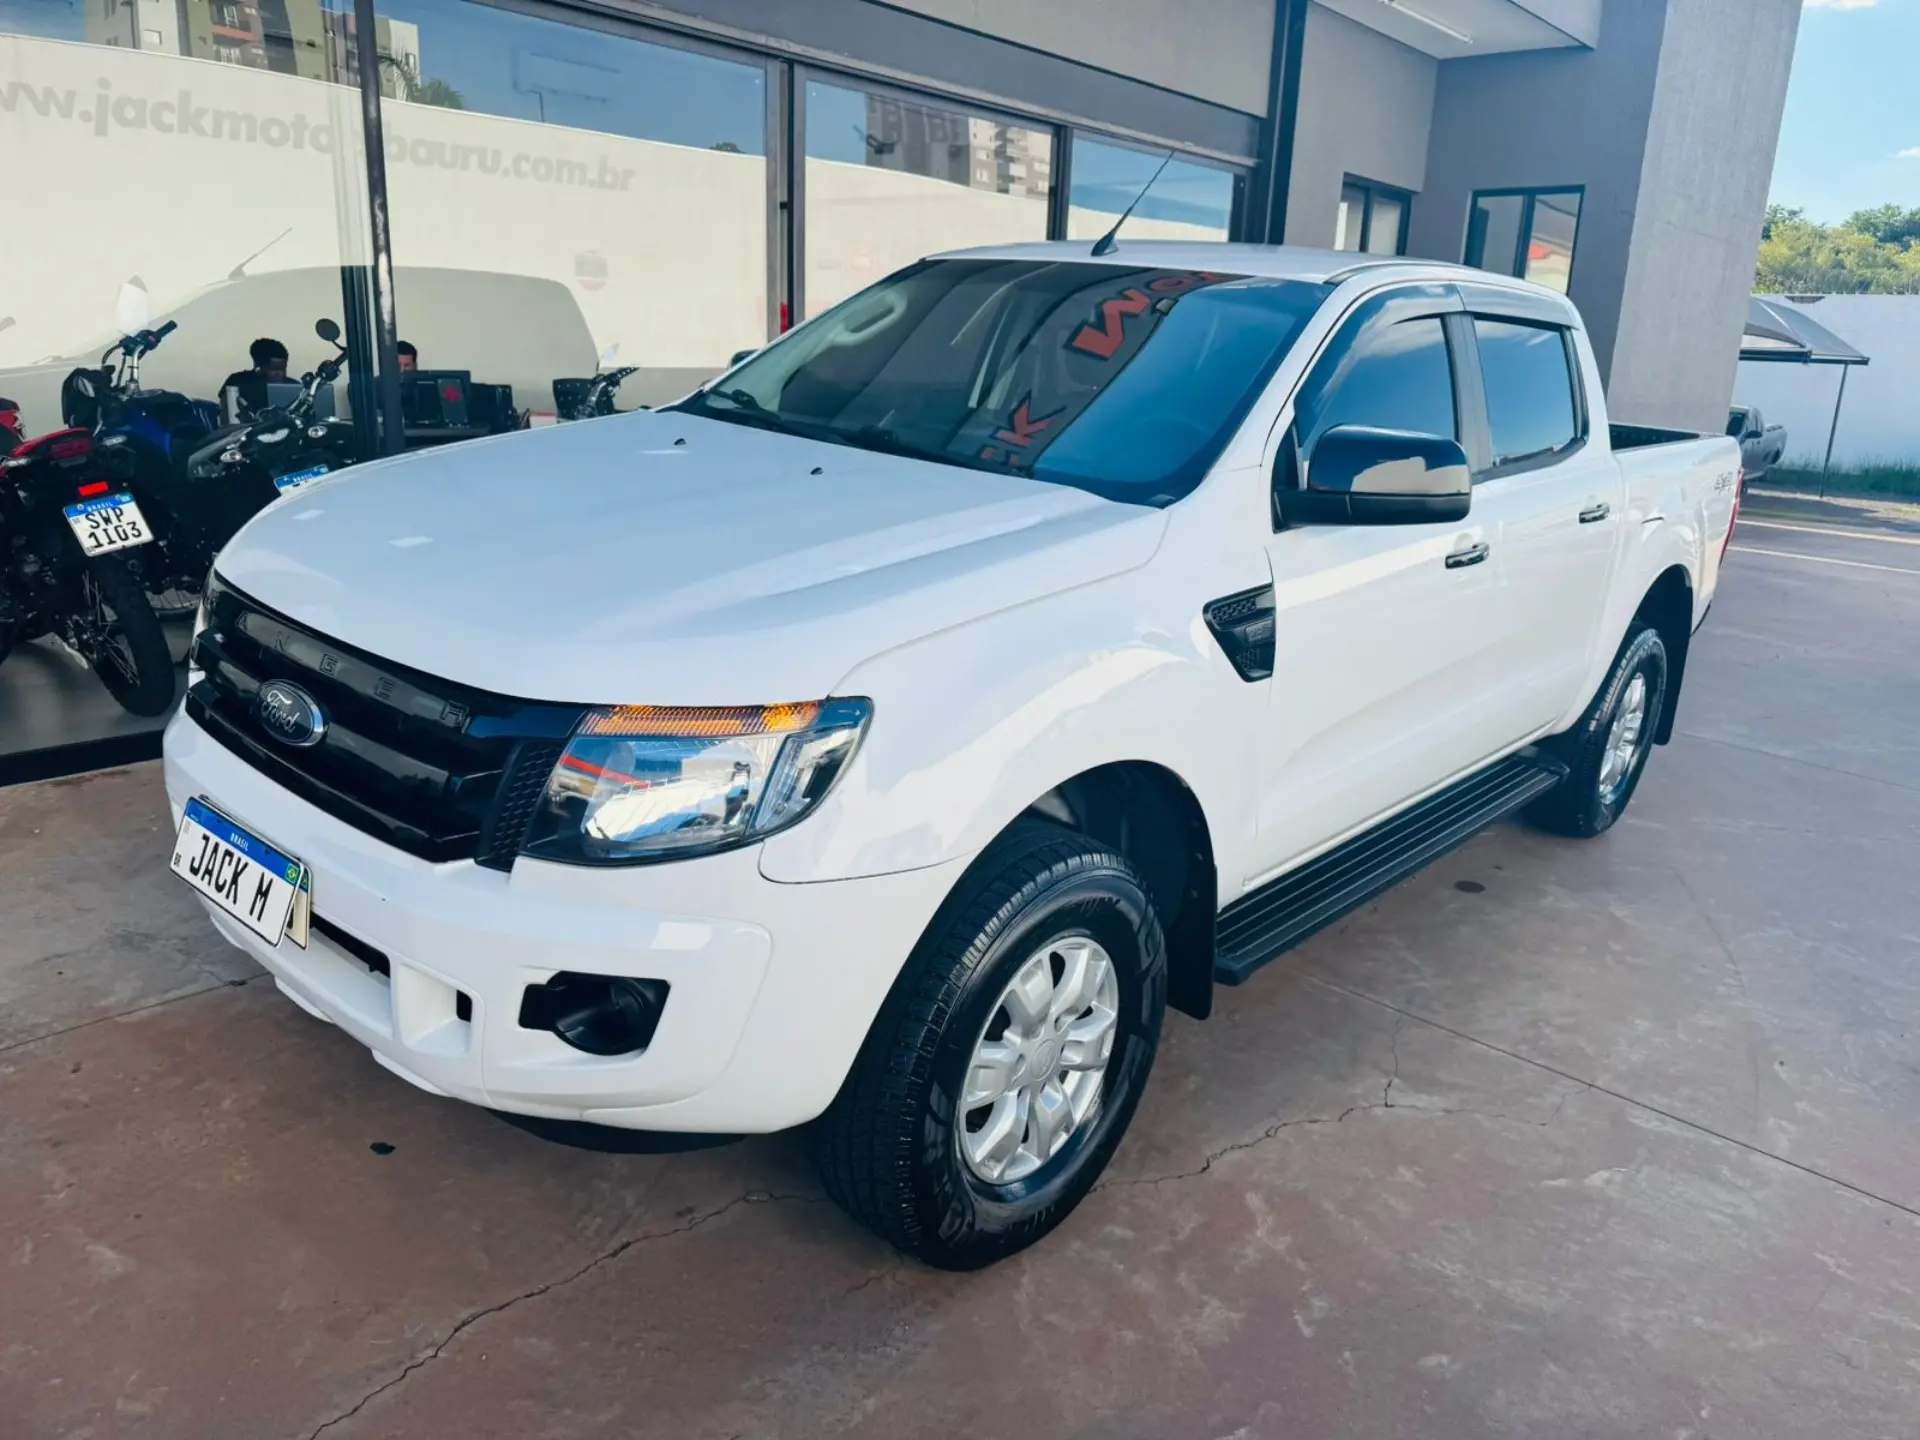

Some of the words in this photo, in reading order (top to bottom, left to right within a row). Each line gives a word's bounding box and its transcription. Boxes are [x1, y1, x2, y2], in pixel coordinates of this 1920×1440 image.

[85, 507, 124, 529] SWP
[261, 690, 300, 733] Ford
[229, 832, 250, 851] BRASIL
[189, 833, 249, 905] JACK
[249, 871, 273, 922] M
